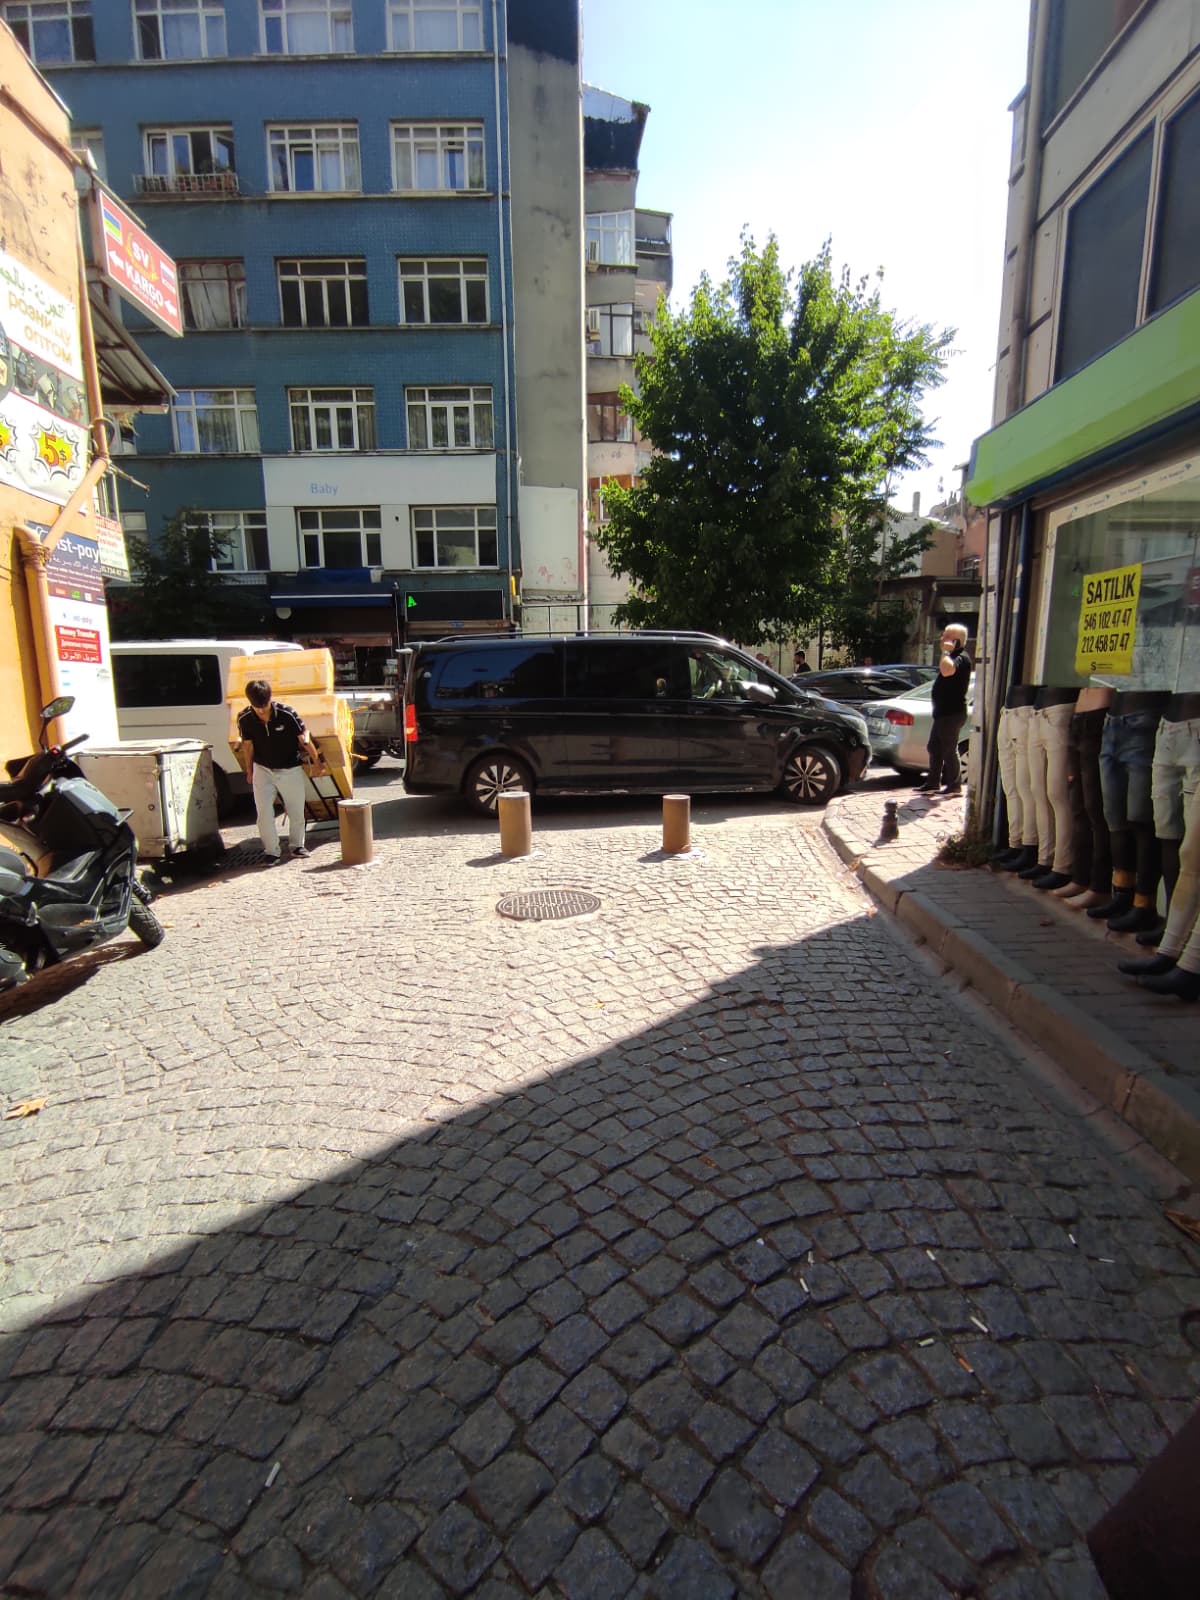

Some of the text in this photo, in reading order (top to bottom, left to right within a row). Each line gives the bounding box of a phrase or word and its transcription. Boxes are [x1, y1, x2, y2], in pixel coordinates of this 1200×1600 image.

[132, 242, 150, 267] SV
[124, 261, 164, 306] KARGO
[24, 325, 73, 366] оптом
[310, 482, 339, 496] Baby
[1086, 572, 1136, 604] SATILIK
[1098, 611, 1111, 629] 102
[1111, 609, 1121, 628] 47
[1122, 608, 1132, 627] 47
[1081, 632, 1130, 653] 212 458 57 47
